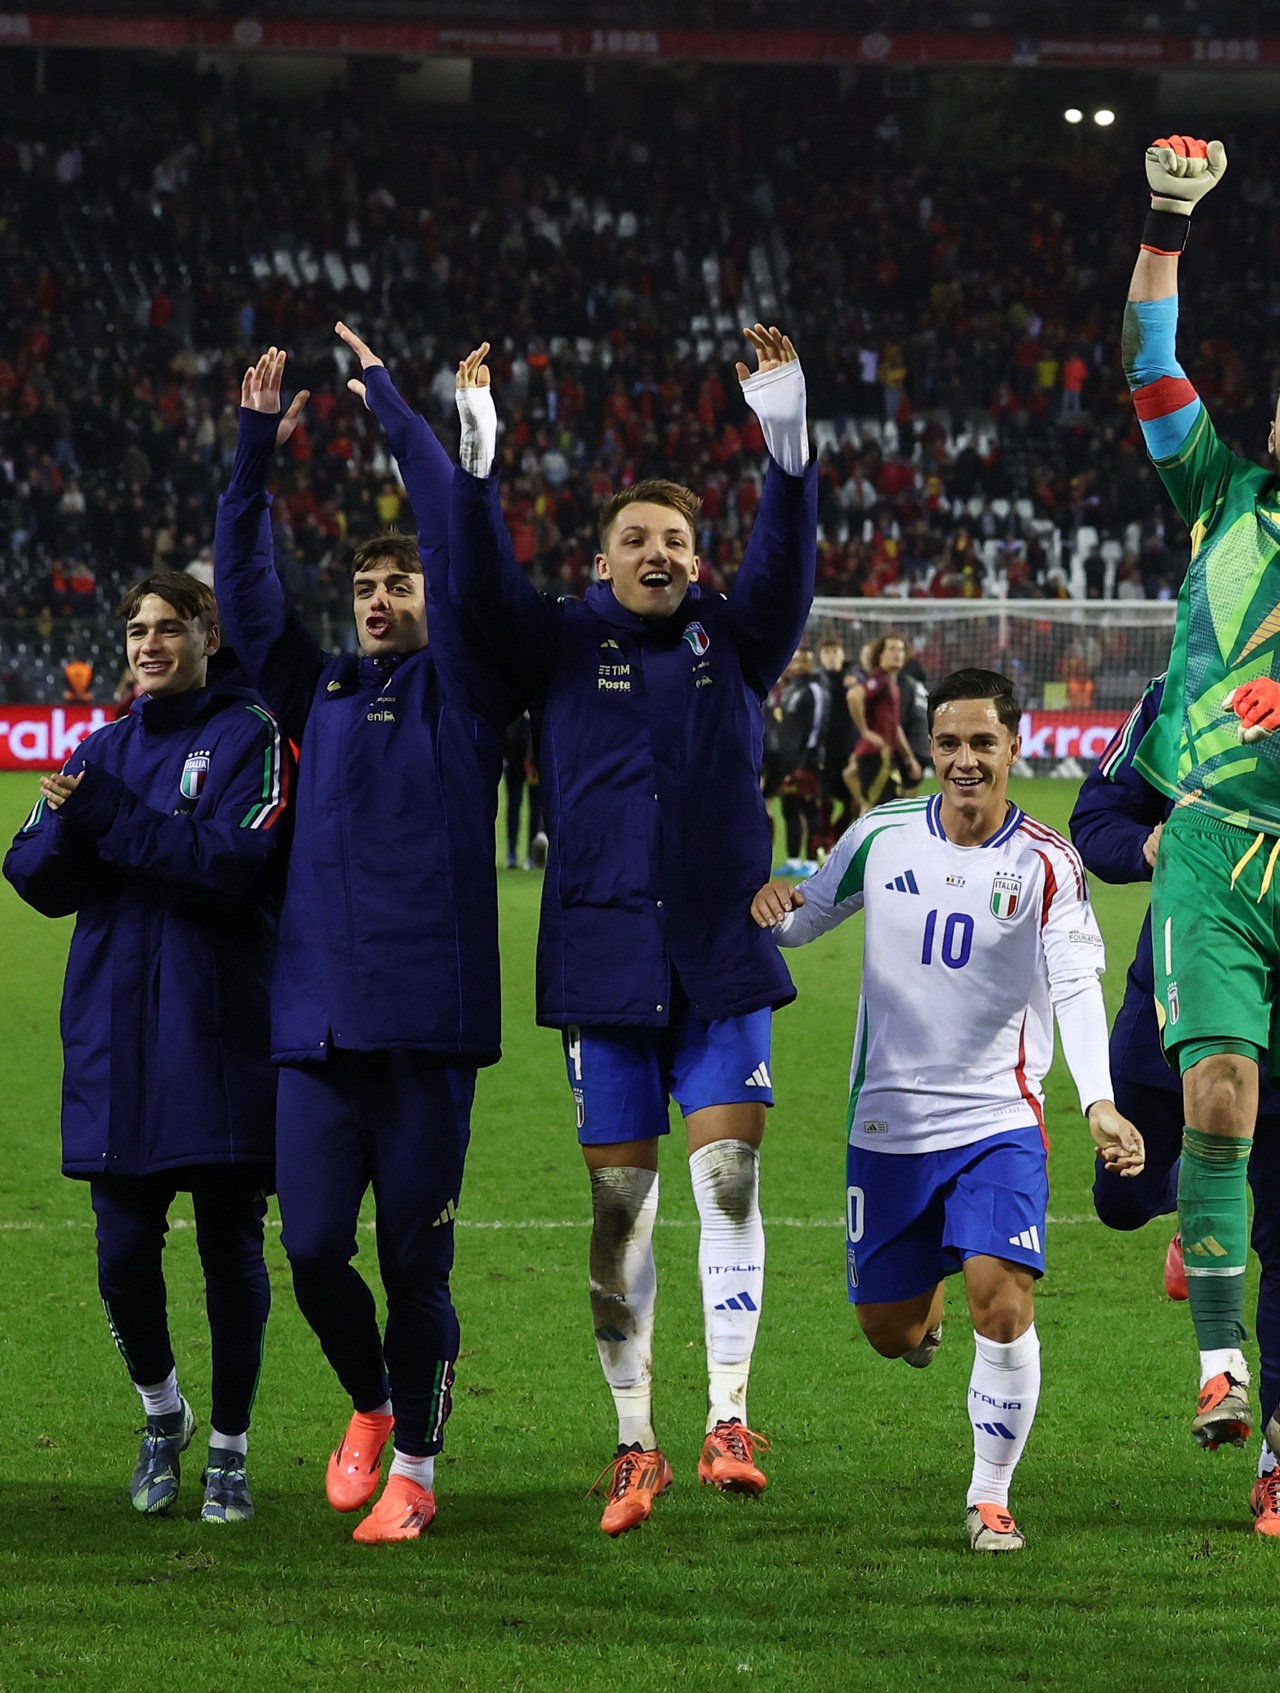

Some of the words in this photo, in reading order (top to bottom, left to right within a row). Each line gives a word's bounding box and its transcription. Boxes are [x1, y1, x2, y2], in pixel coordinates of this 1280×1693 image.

[611, 664, 630, 676] TIM
[598, 678, 631, 690] Poste
[995, 880, 1019, 892] ITALIA
[921, 909, 975, 970] 10
[1164, 916, 1172, 976] 1
[708, 1264, 761, 1275] ITALIA
